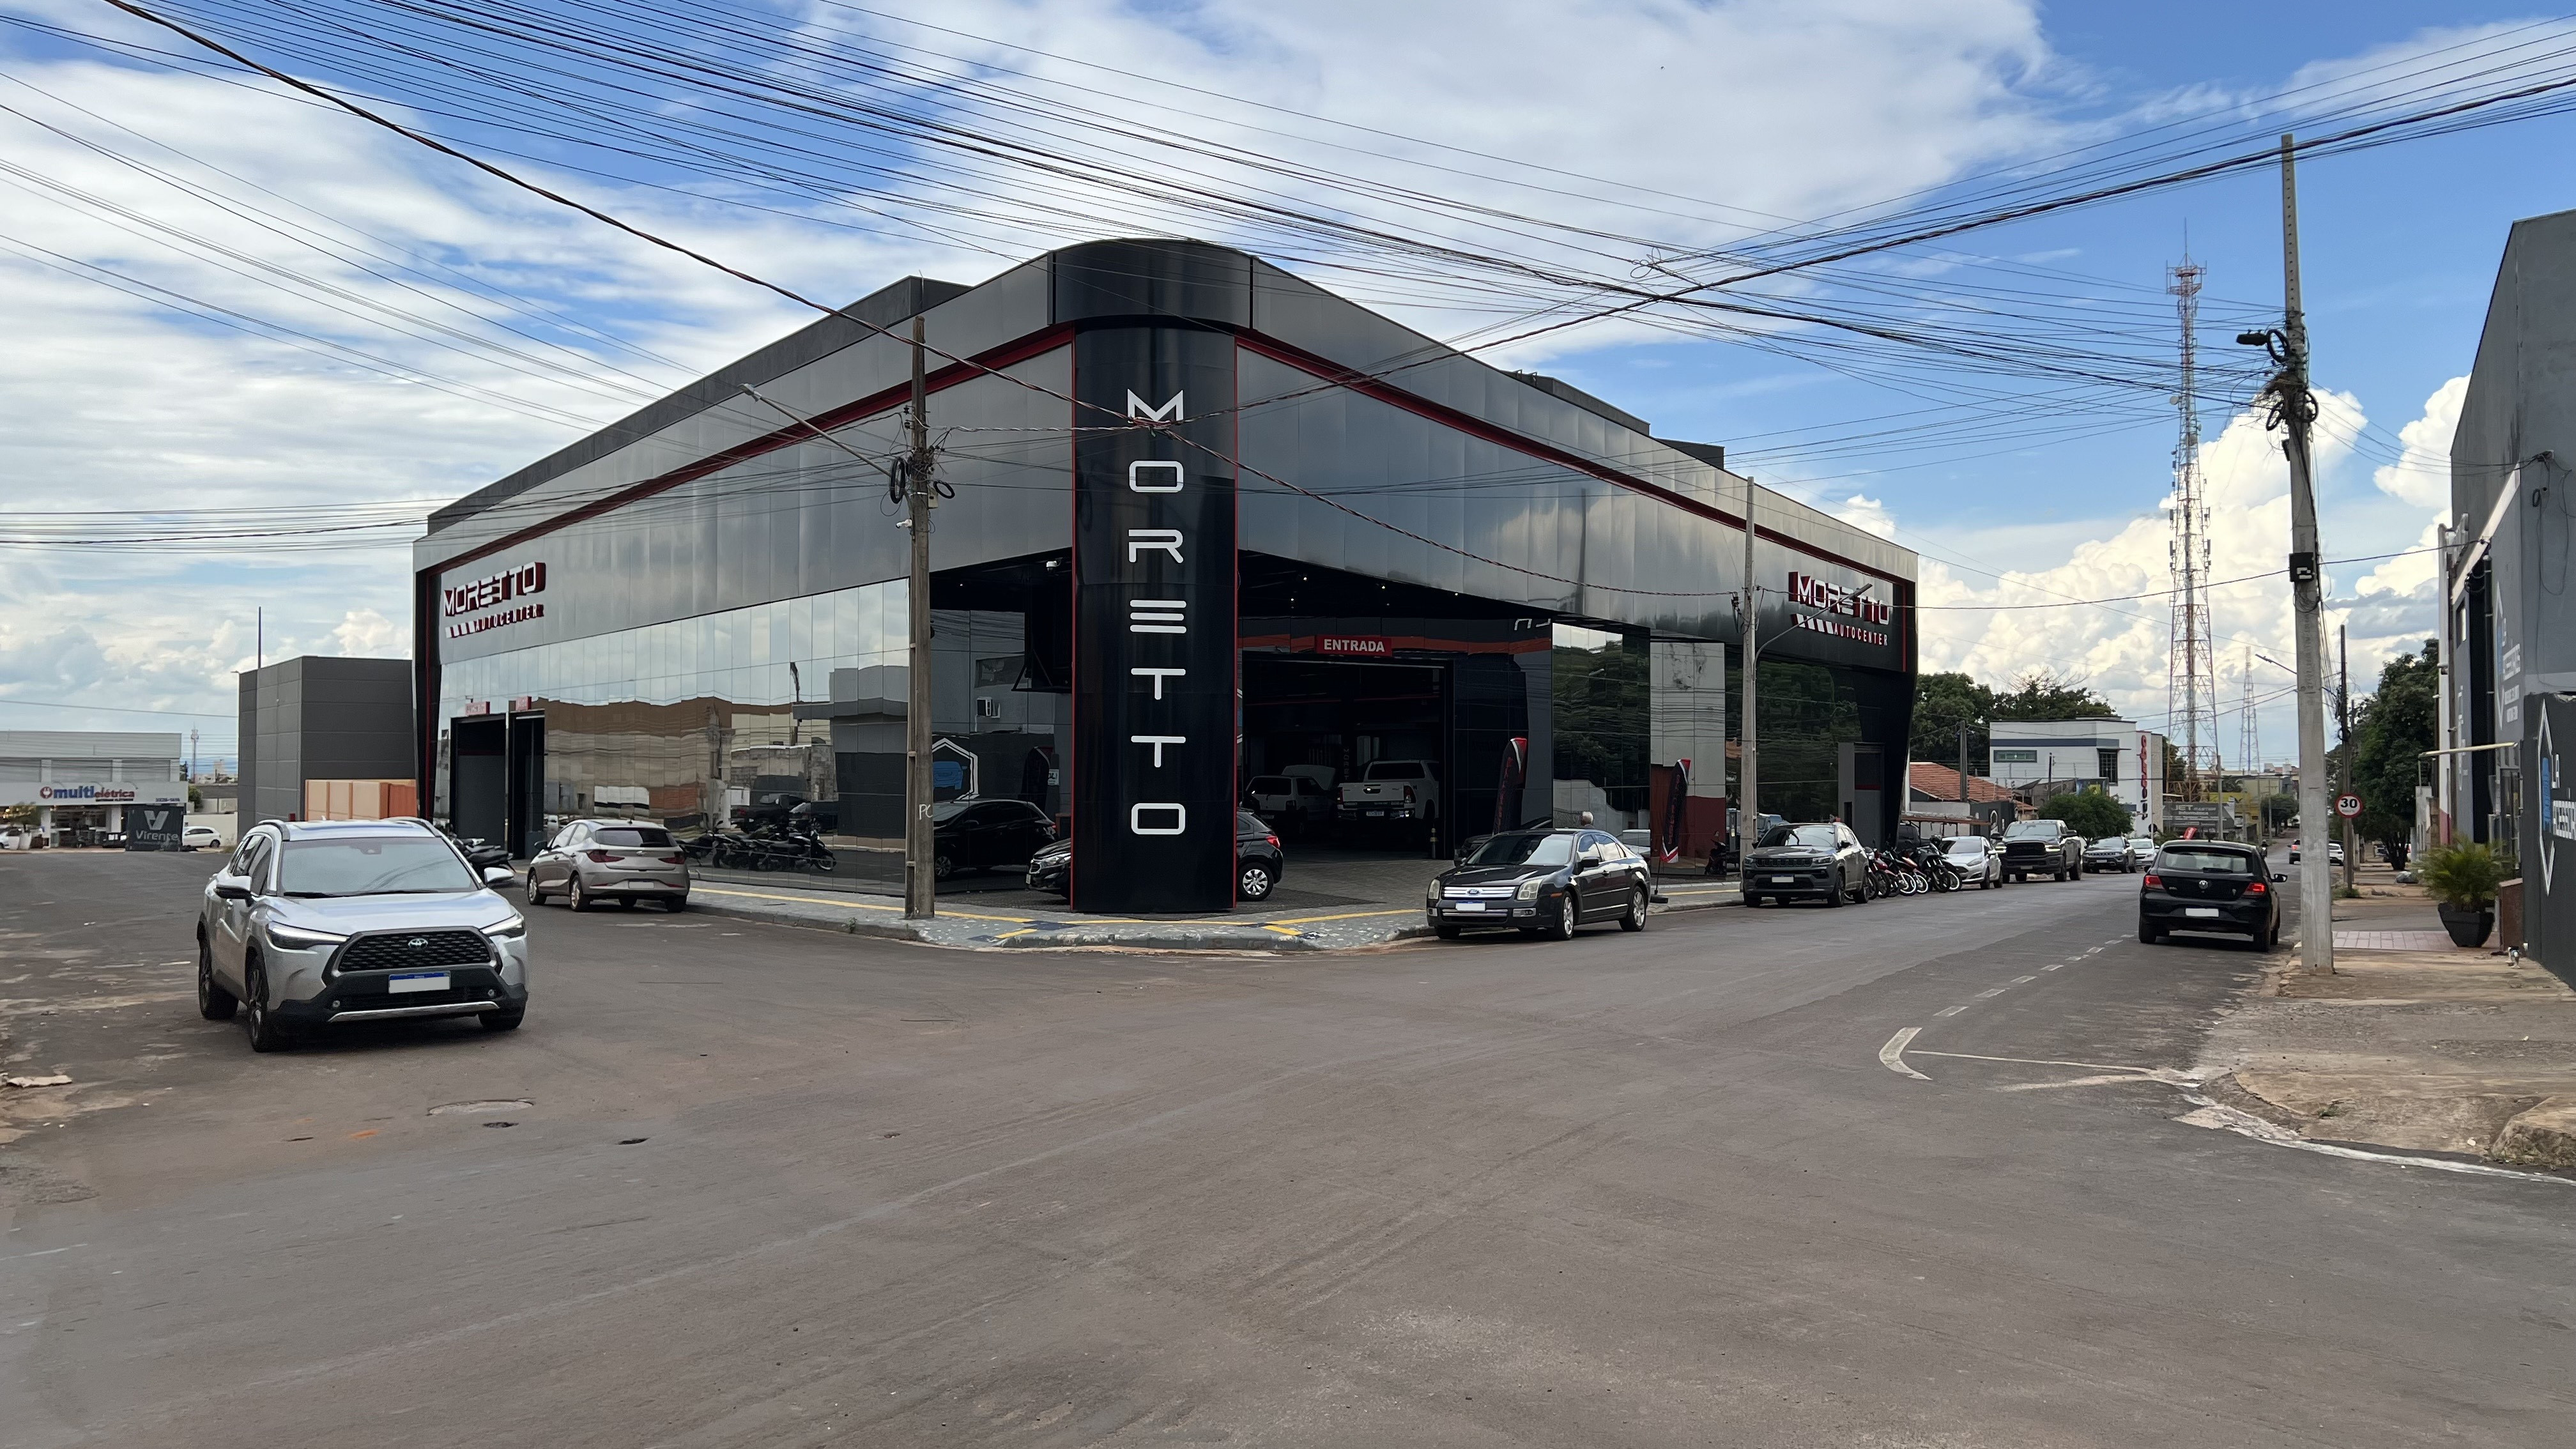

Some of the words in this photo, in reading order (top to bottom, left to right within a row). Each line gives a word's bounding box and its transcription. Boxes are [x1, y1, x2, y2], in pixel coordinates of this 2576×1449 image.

[443, 562, 546, 617] MORETTO
[1788, 572, 1889, 625] MORETTO
[475, 603, 543, 632] AUTOCENTER
[1127, 388, 1186, 835] MORETTO
[1324, 638, 1385, 652] ENTRADA
[1834, 622, 1888, 646] AUTOCENTER
[2340, 798, 2358, 808] 30
[135, 830, 180, 841] Virente
